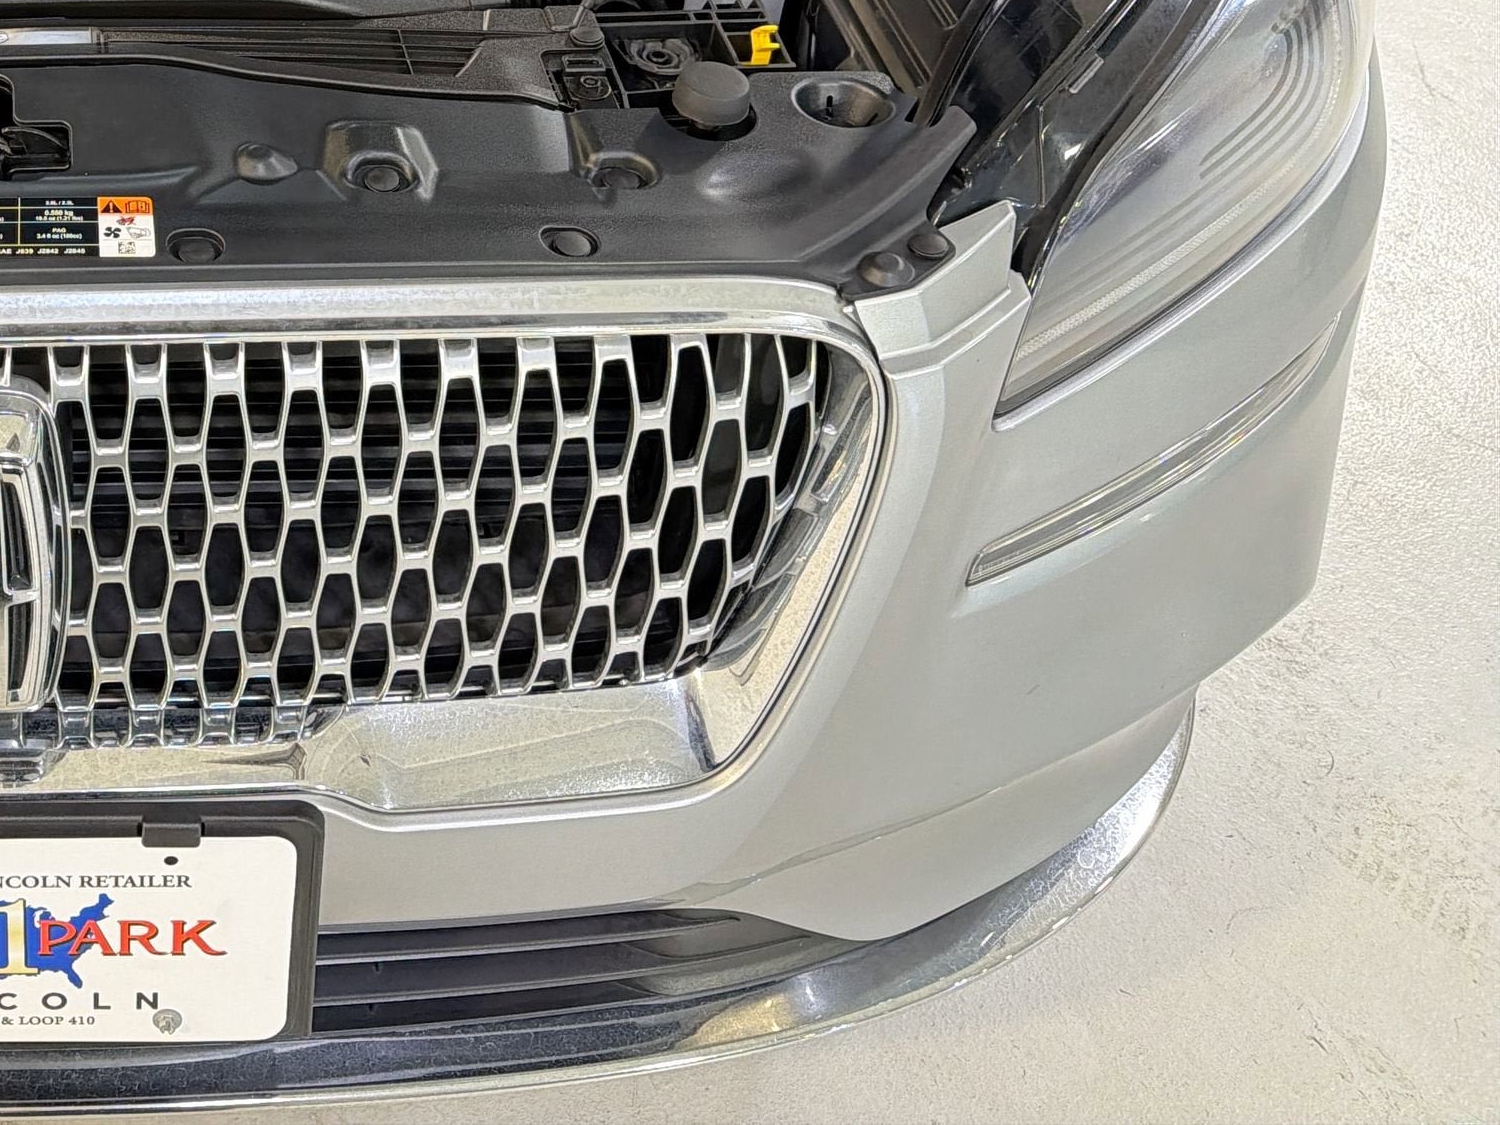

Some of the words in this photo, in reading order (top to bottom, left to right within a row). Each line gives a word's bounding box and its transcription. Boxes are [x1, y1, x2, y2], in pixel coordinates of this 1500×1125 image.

[78, 875, 193, 888] RETAILER
[37, 919, 228, 957] PARK
[1, 1015, 14, 1025] &
[19, 1015, 64, 1025] LOOP
[68, 1015, 96, 1025] 410
